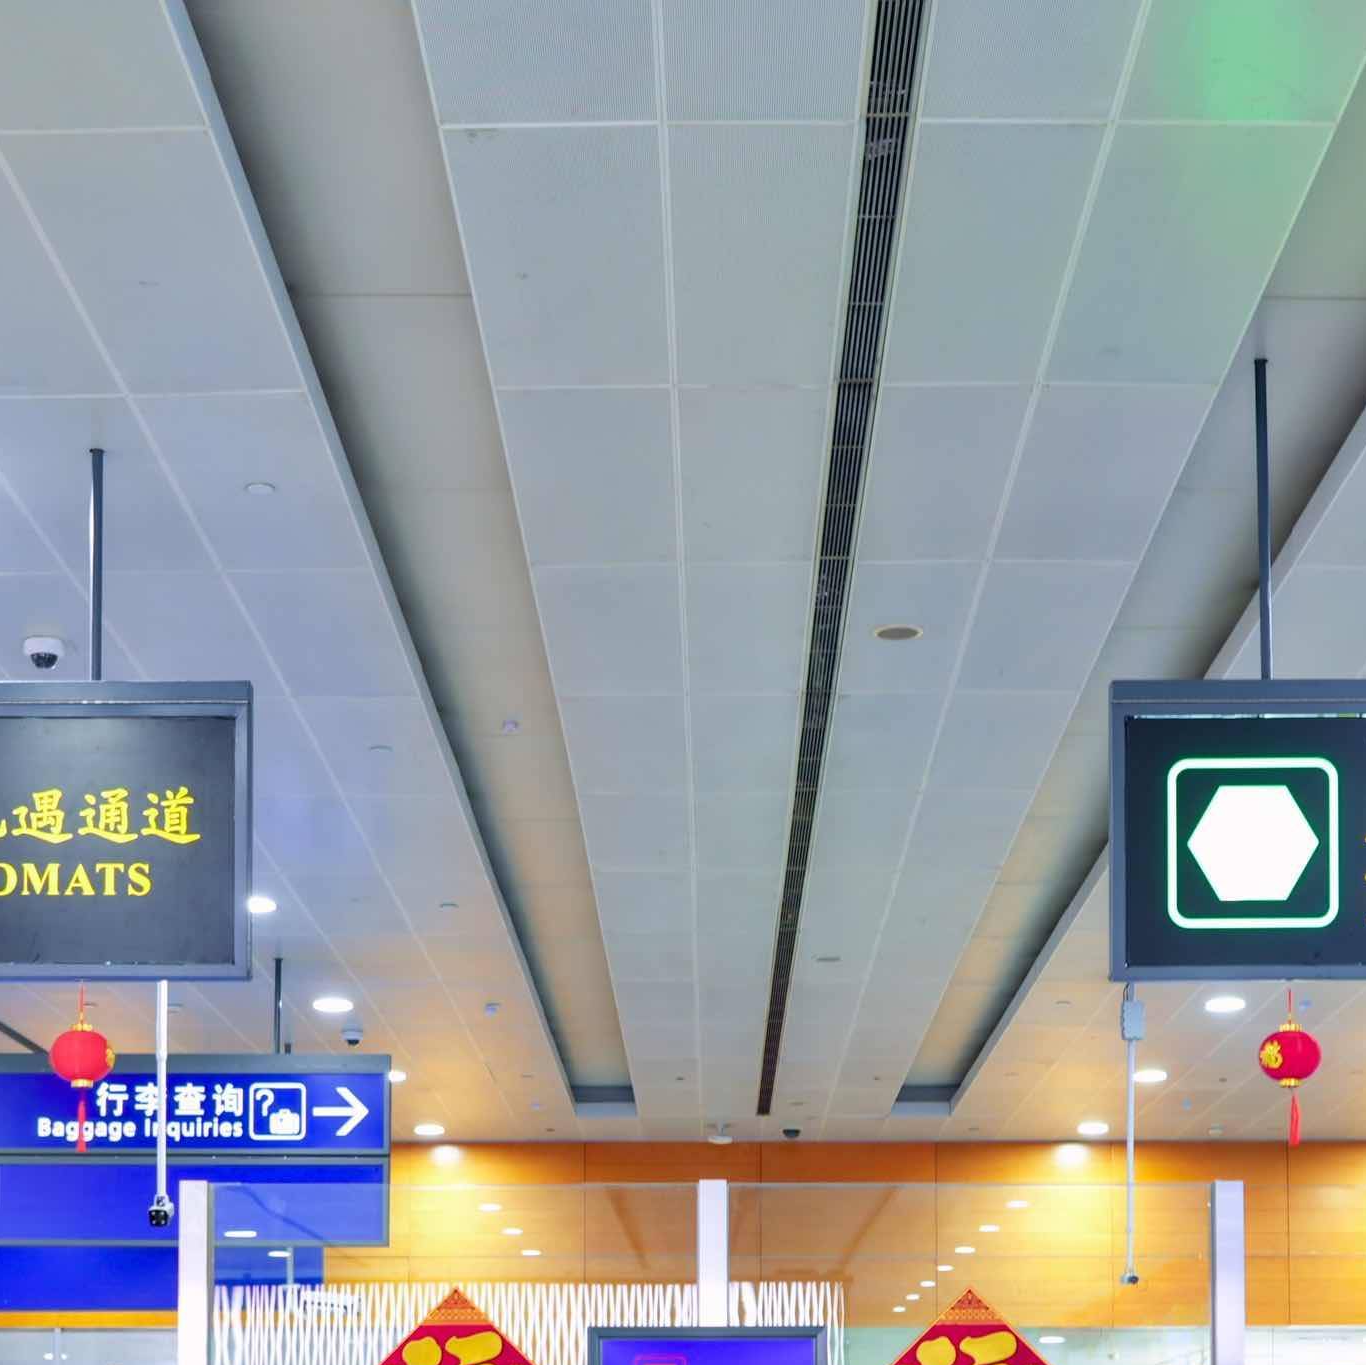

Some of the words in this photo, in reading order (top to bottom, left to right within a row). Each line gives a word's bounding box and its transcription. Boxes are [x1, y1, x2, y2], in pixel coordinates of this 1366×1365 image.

[96, 1082, 245, 1117] 行李查询
[37, 1117, 137, 1142] Baggage
